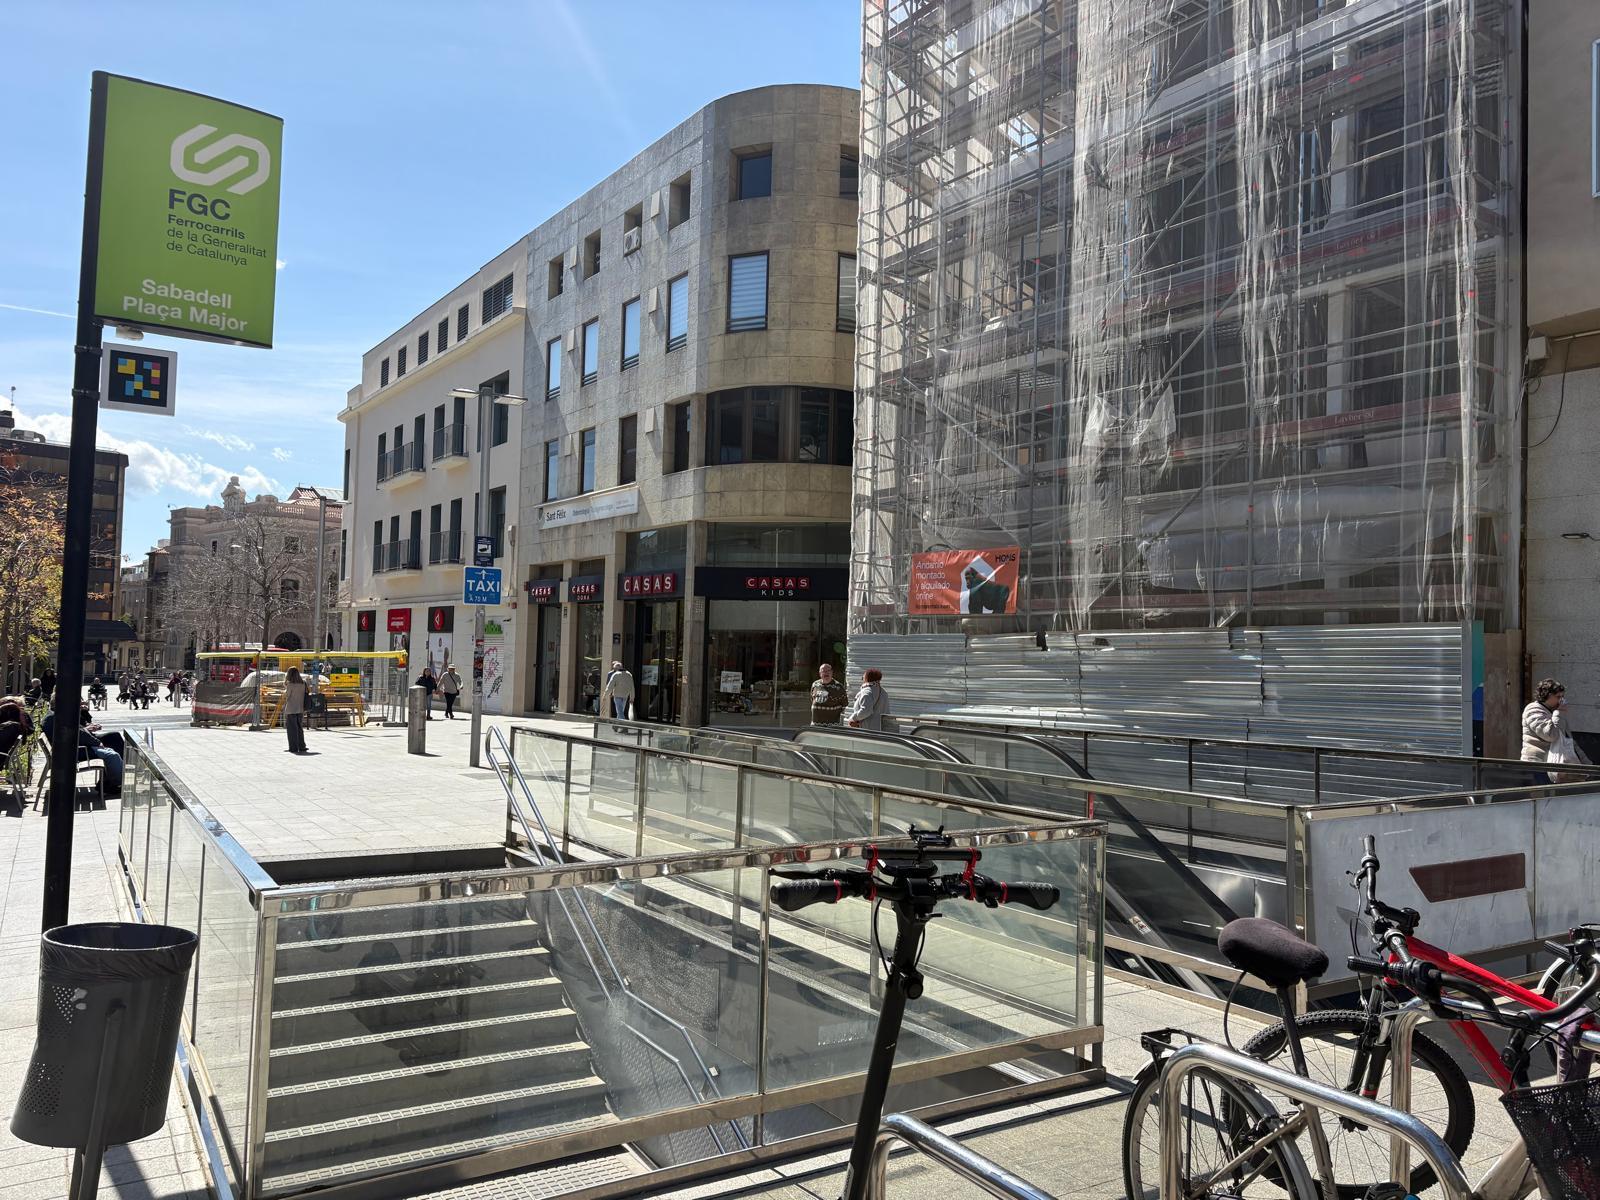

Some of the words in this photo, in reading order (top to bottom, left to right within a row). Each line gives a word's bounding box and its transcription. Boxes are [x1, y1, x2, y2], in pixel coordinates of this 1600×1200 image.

[168, 188, 231, 221] FGC
[168, 213, 246, 240] Ferrocarrils
[167, 227, 183, 239] de
[187, 230, 198, 242] la
[202, 233, 267, 258] Generalitat
[166, 240, 183, 252] de
[186, 243, 247, 266] Catalunya
[141, 278, 232, 309] Sabadell
[122, 295, 182, 321] Plaça
[189, 305, 248, 332] Major
[466, 579, 500, 593] TAXI
[531, 586, 552, 596] CASAS
[571, 584, 596, 594] CASAS
[623, 576, 673, 593] CASAS
[747, 577, 808, 588] CASAS
[920, 581, 951, 591] alquilado
[761, 589, 794, 597] KIDS
